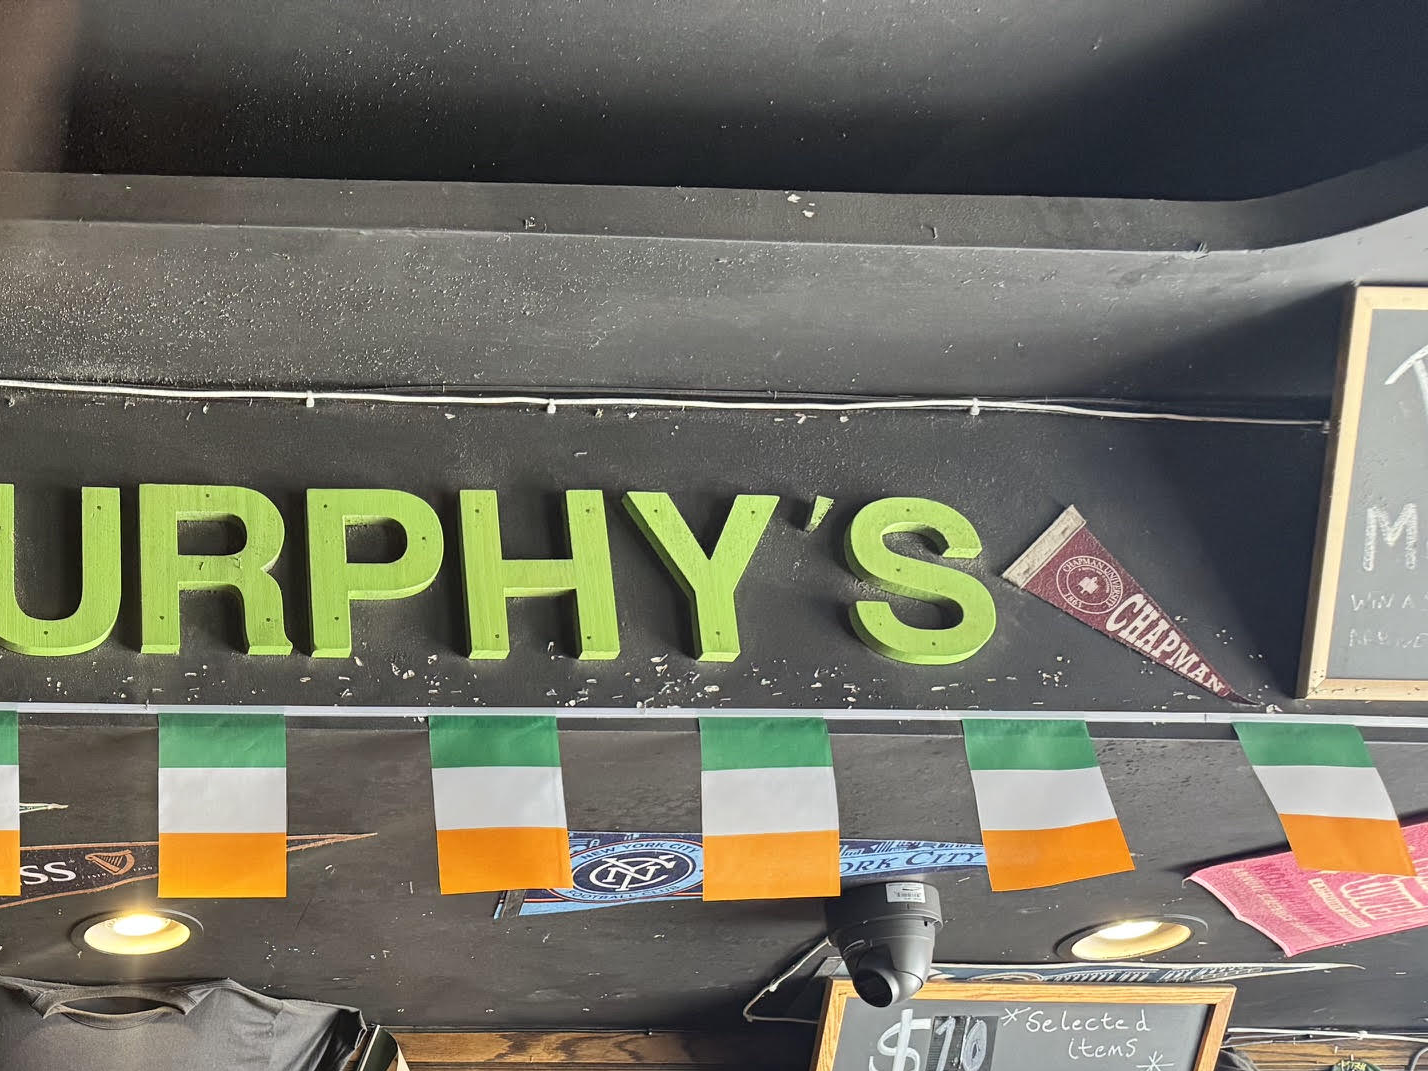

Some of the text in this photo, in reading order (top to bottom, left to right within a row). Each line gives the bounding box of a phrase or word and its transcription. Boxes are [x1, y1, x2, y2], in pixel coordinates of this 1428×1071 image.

[1105, 593, 1226, 693] CHAPMAN
[580, 841, 700, 860] NEW YORK CITY
[904, 849, 985, 867] CITY
